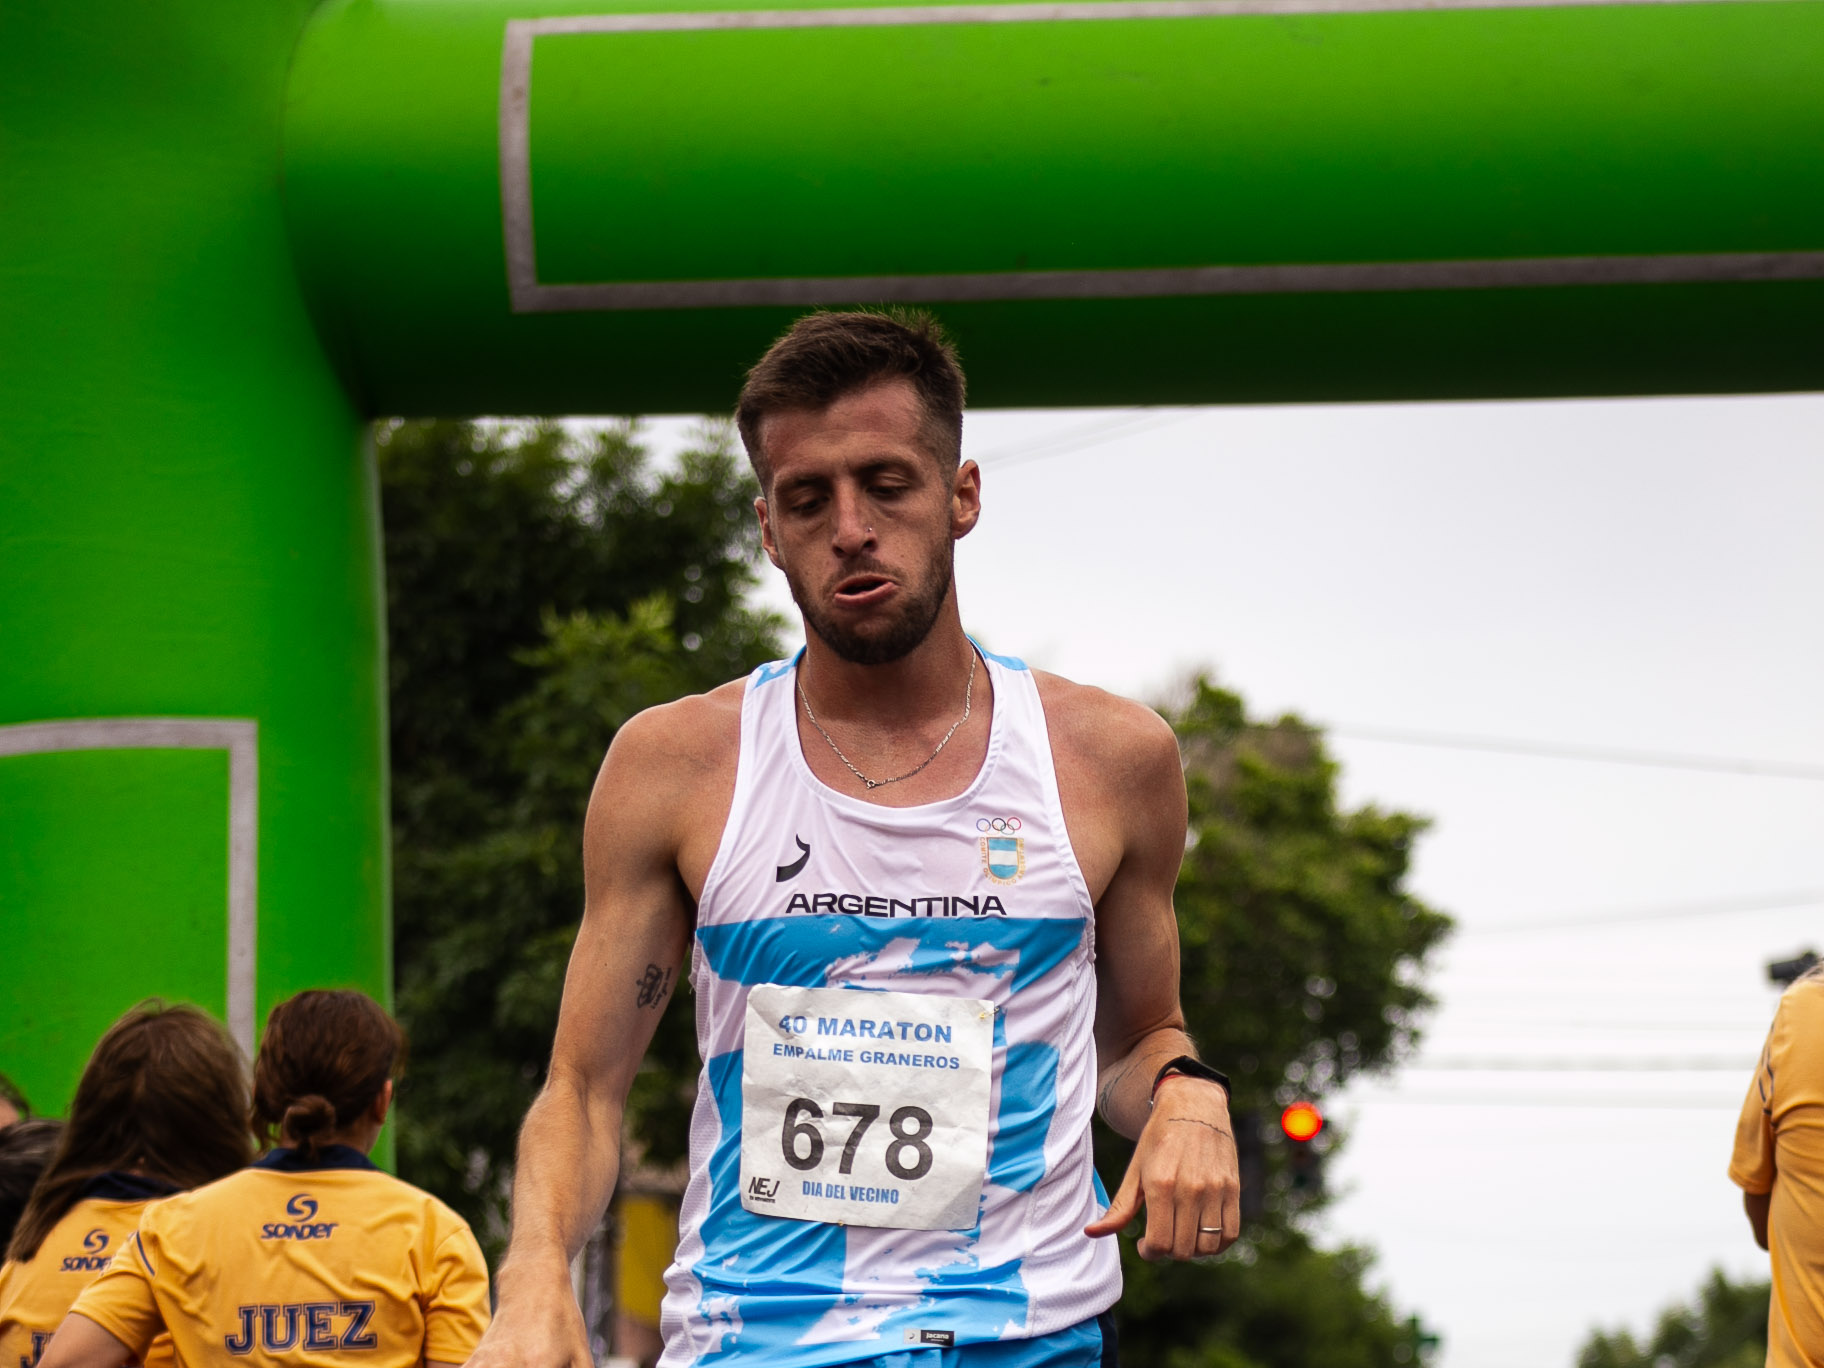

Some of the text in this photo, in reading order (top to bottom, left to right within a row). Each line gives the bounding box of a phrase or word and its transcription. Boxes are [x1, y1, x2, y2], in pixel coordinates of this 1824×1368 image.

[785, 892, 1007, 918] ARGENTINA
[778, 1015, 952, 1044] 40 MARATON
[773, 1043, 960, 1070] EMPALME GRANEROS
[781, 1097, 933, 1181] 678
[748, 1176, 780, 1198] NEJ
[802, 1180, 900, 1205] DIA DEL VECINO
[225, 1300, 378, 1355] JUEZ
